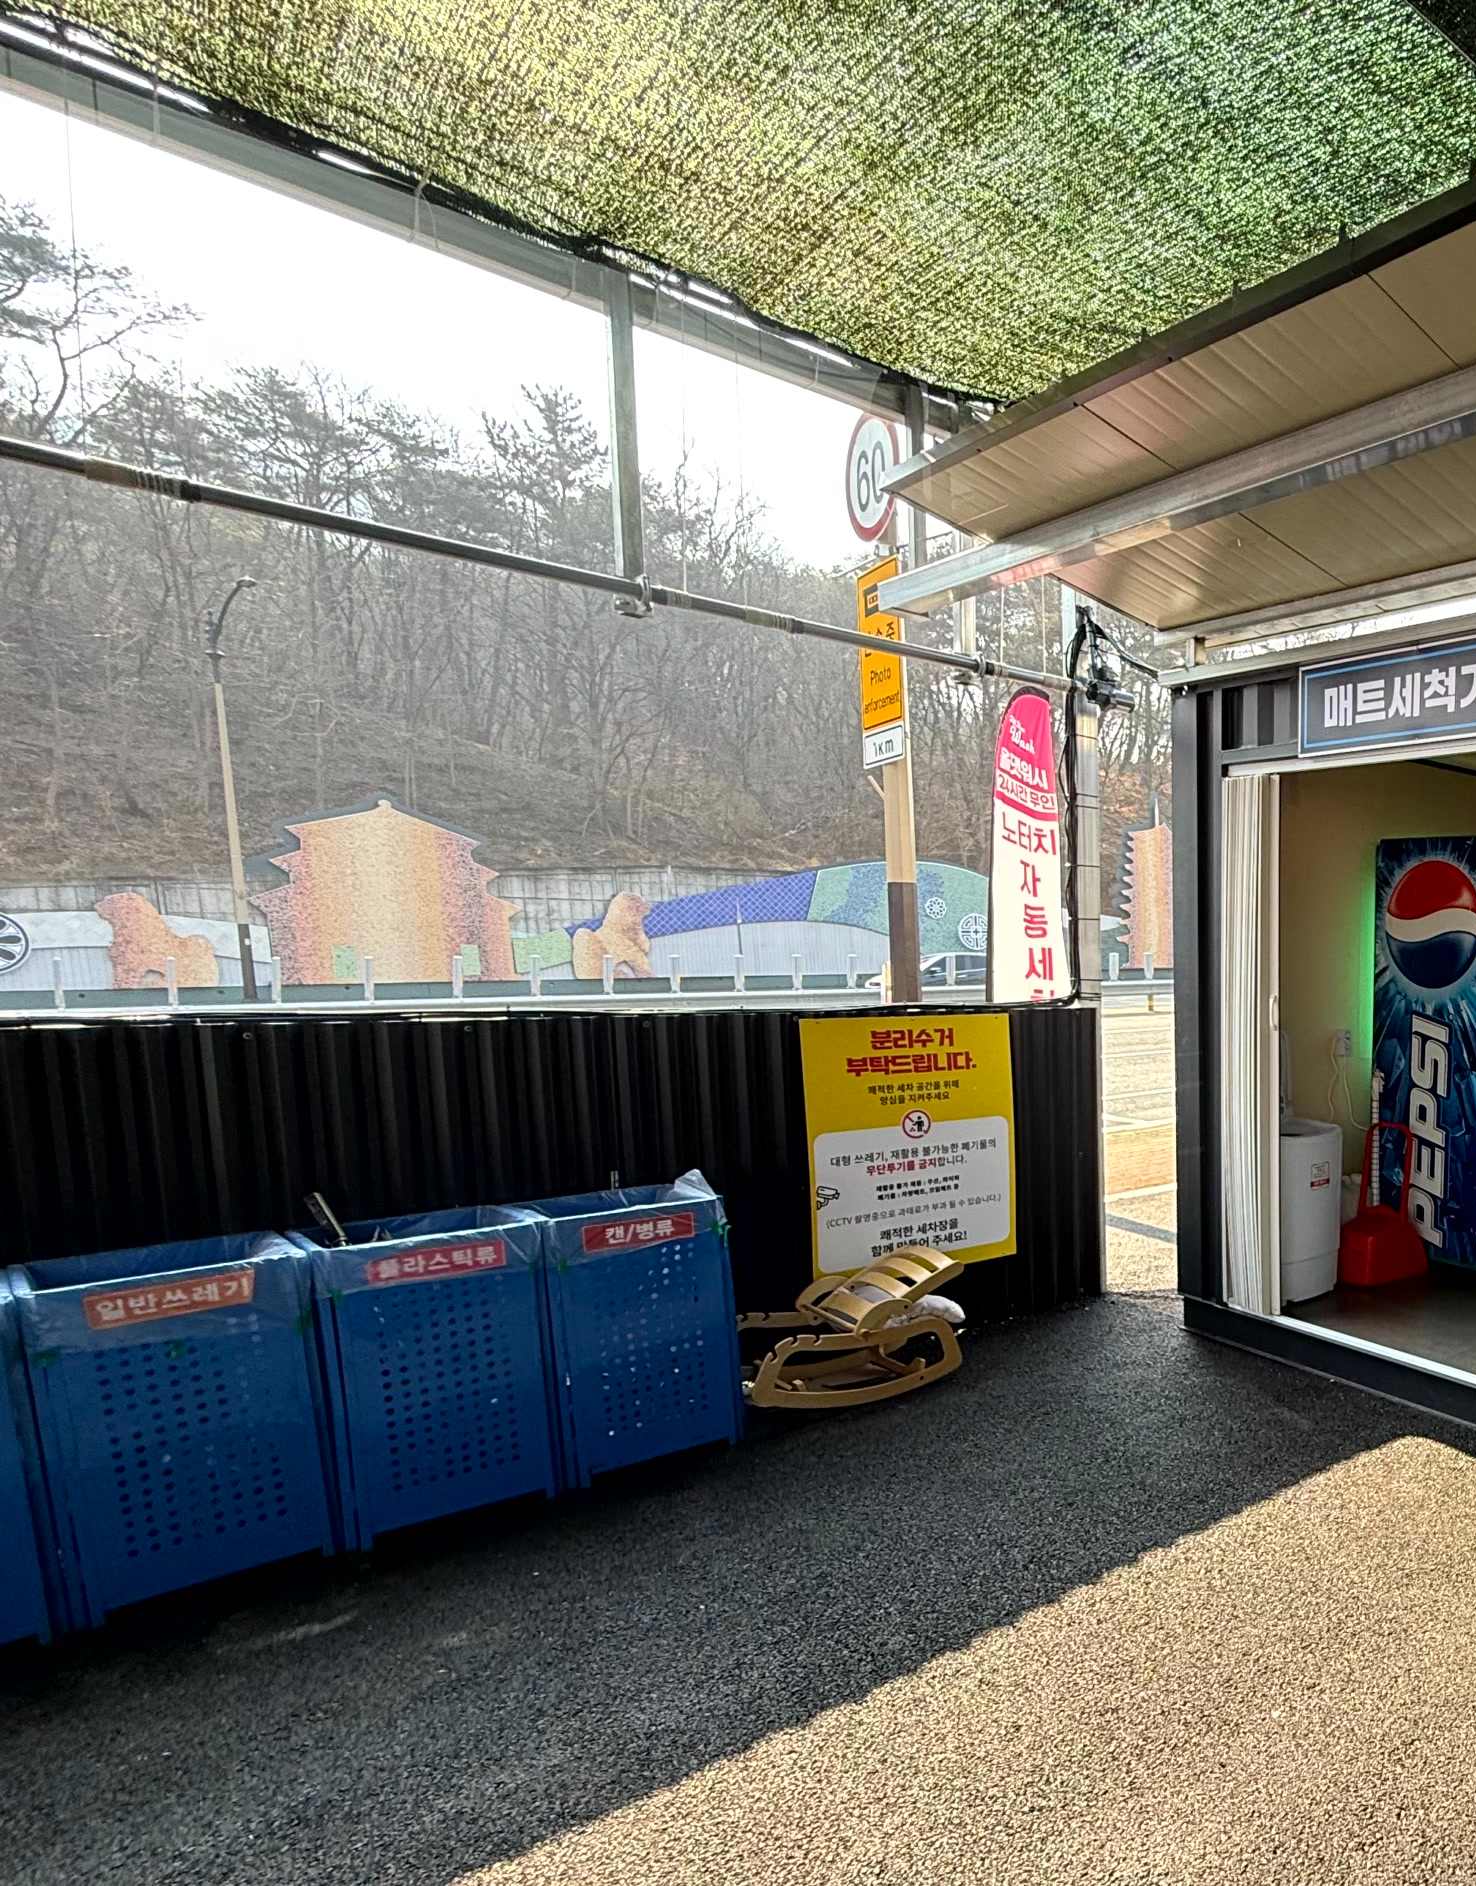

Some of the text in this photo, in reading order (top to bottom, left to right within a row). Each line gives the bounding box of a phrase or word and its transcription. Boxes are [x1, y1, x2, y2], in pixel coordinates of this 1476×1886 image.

[857, 440, 887, 513] 60
[870, 666, 892, 687] Photo
[864, 692, 901, 714] enforcement
[999, 773, 1056, 811] 24시간 무인
[1002, 811, 1057, 855] 노터치
[870, 1028, 955, 1051] 분리수거
[846, 1051, 977, 1077] 부탁드립니다.
[868, 1080, 960, 1095] 쾌적한 세차 공간을 위해
[880, 1091, 950, 1106] 양심을 지켜주세요
[1409, 1015, 1451, 1248] PEPSI
[830, 1138, 997, 1167] 대형 쓰레기, 재활용 불가능한 폐기물의
[866, 1154, 968, 1176] 무단투기를 금지합니다.
[826, 1216, 852, 1229] (CCTV
[854, 1209, 896, 1225] 촬영중으로
[898, 1204, 930, 1217] 과태료가
[932, 1201, 947, 1212] 부과
[958, 1199, 965, 1207] 수
[605, 1219, 675, 1244] 캔/병류
[879, 1218, 960, 1241] 쾌적한 세차장을
[870, 1243, 895, 1258] 함께
[932, 1230, 968, 1245] 주세요!
[377, 1246, 498, 1280] 플라스틱류
[95, 1277, 250, 1322] 일반쓰레기
